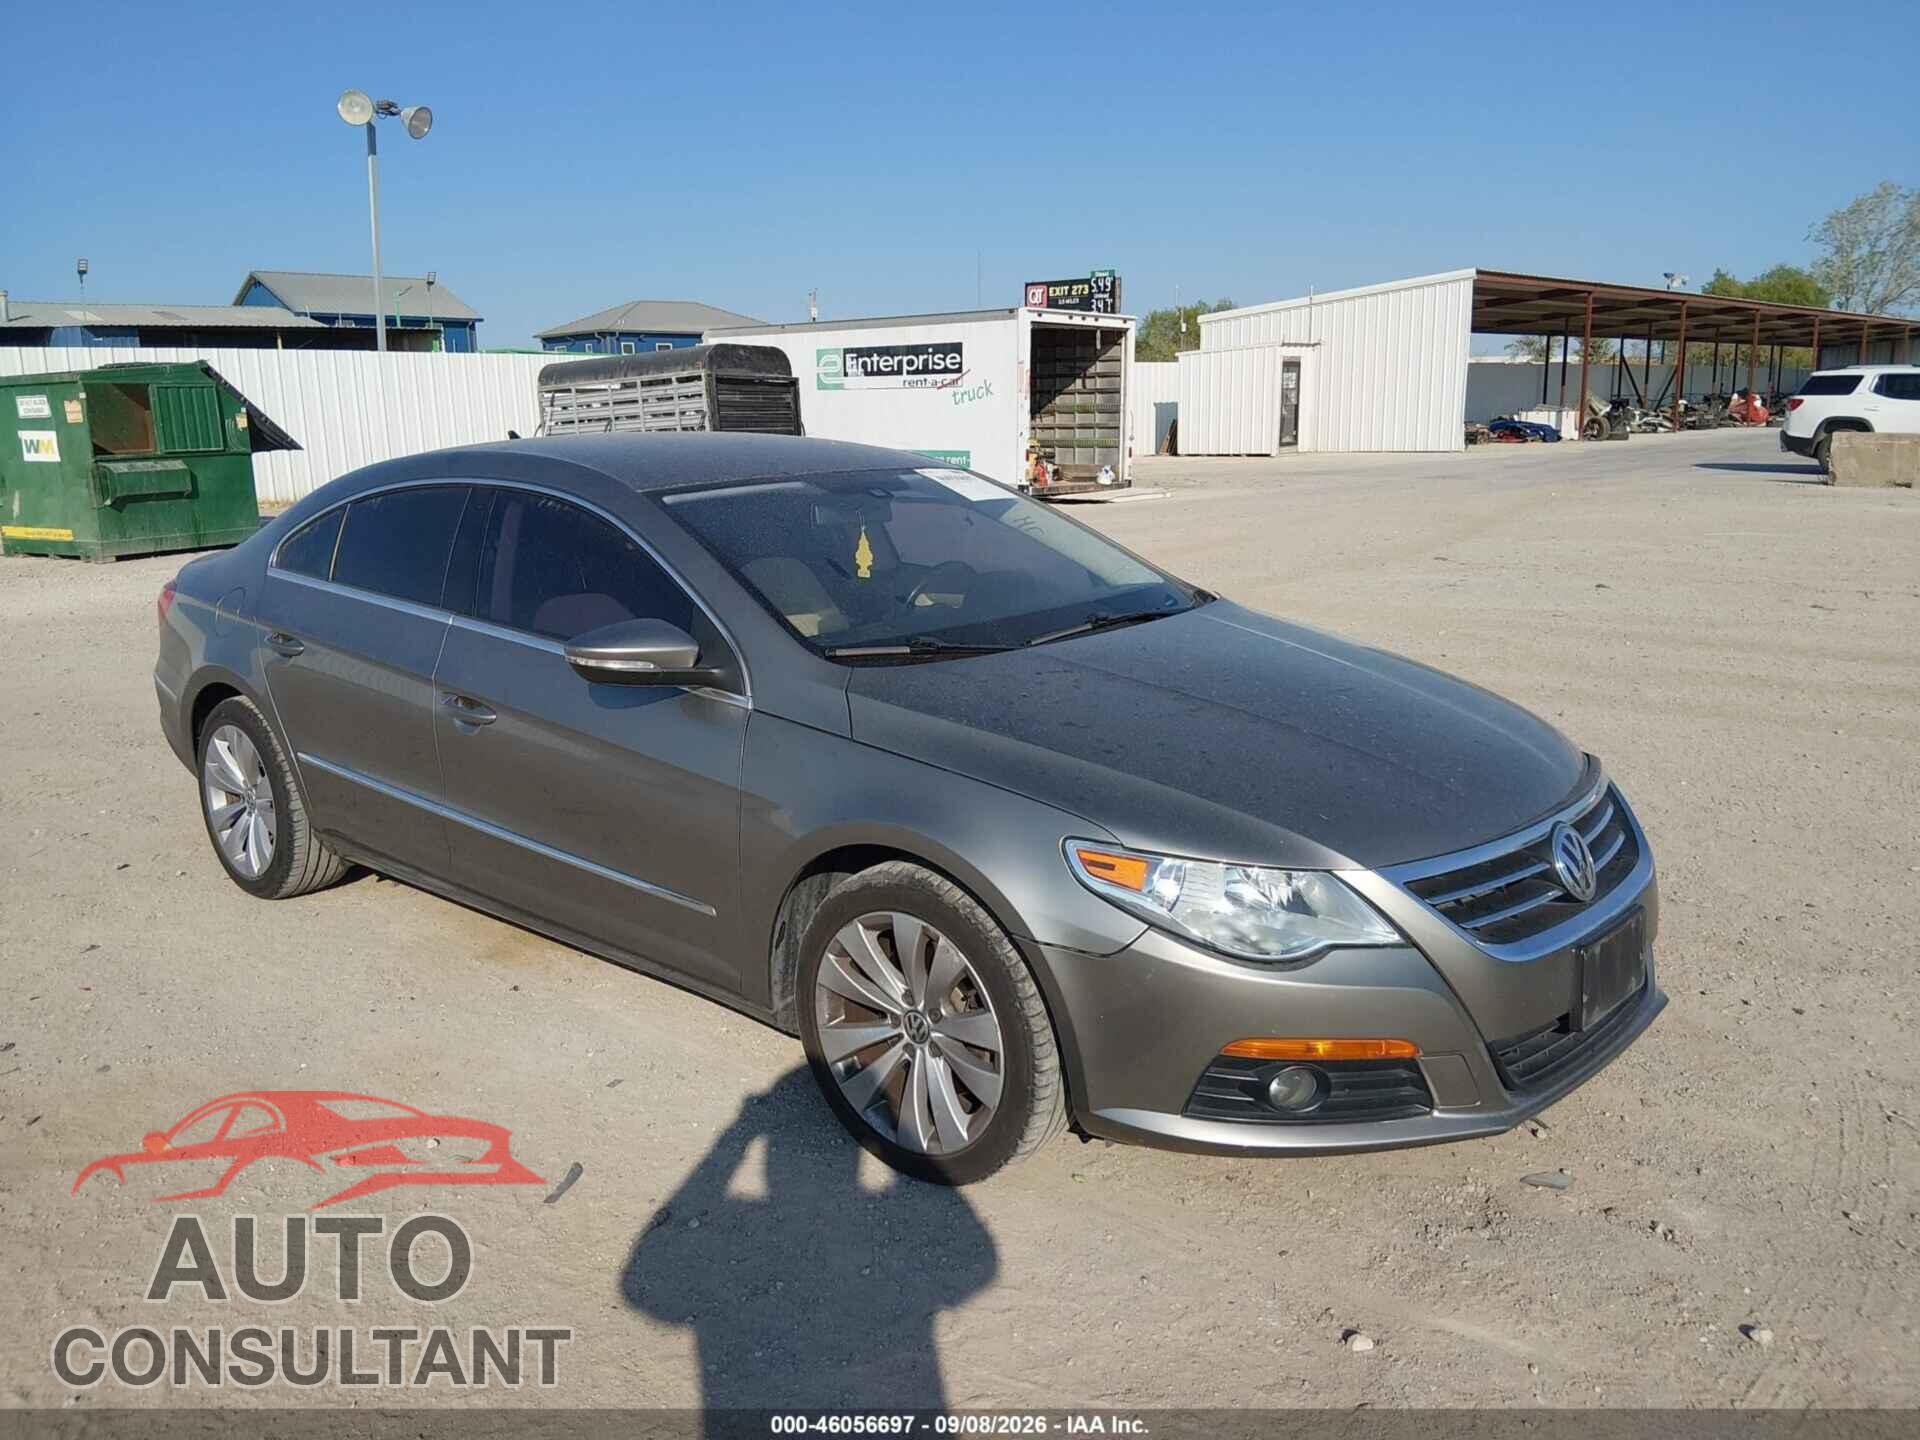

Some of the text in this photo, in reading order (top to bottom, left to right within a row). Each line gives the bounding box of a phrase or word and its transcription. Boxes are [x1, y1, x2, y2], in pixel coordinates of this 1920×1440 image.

[1029, 287, 1044, 305] QT
[1049, 284, 1089, 297] EXIT 273
[845, 347, 961, 376] Enterprise
[952, 379, 994, 405] truck
[24, 439, 55, 455] WM
